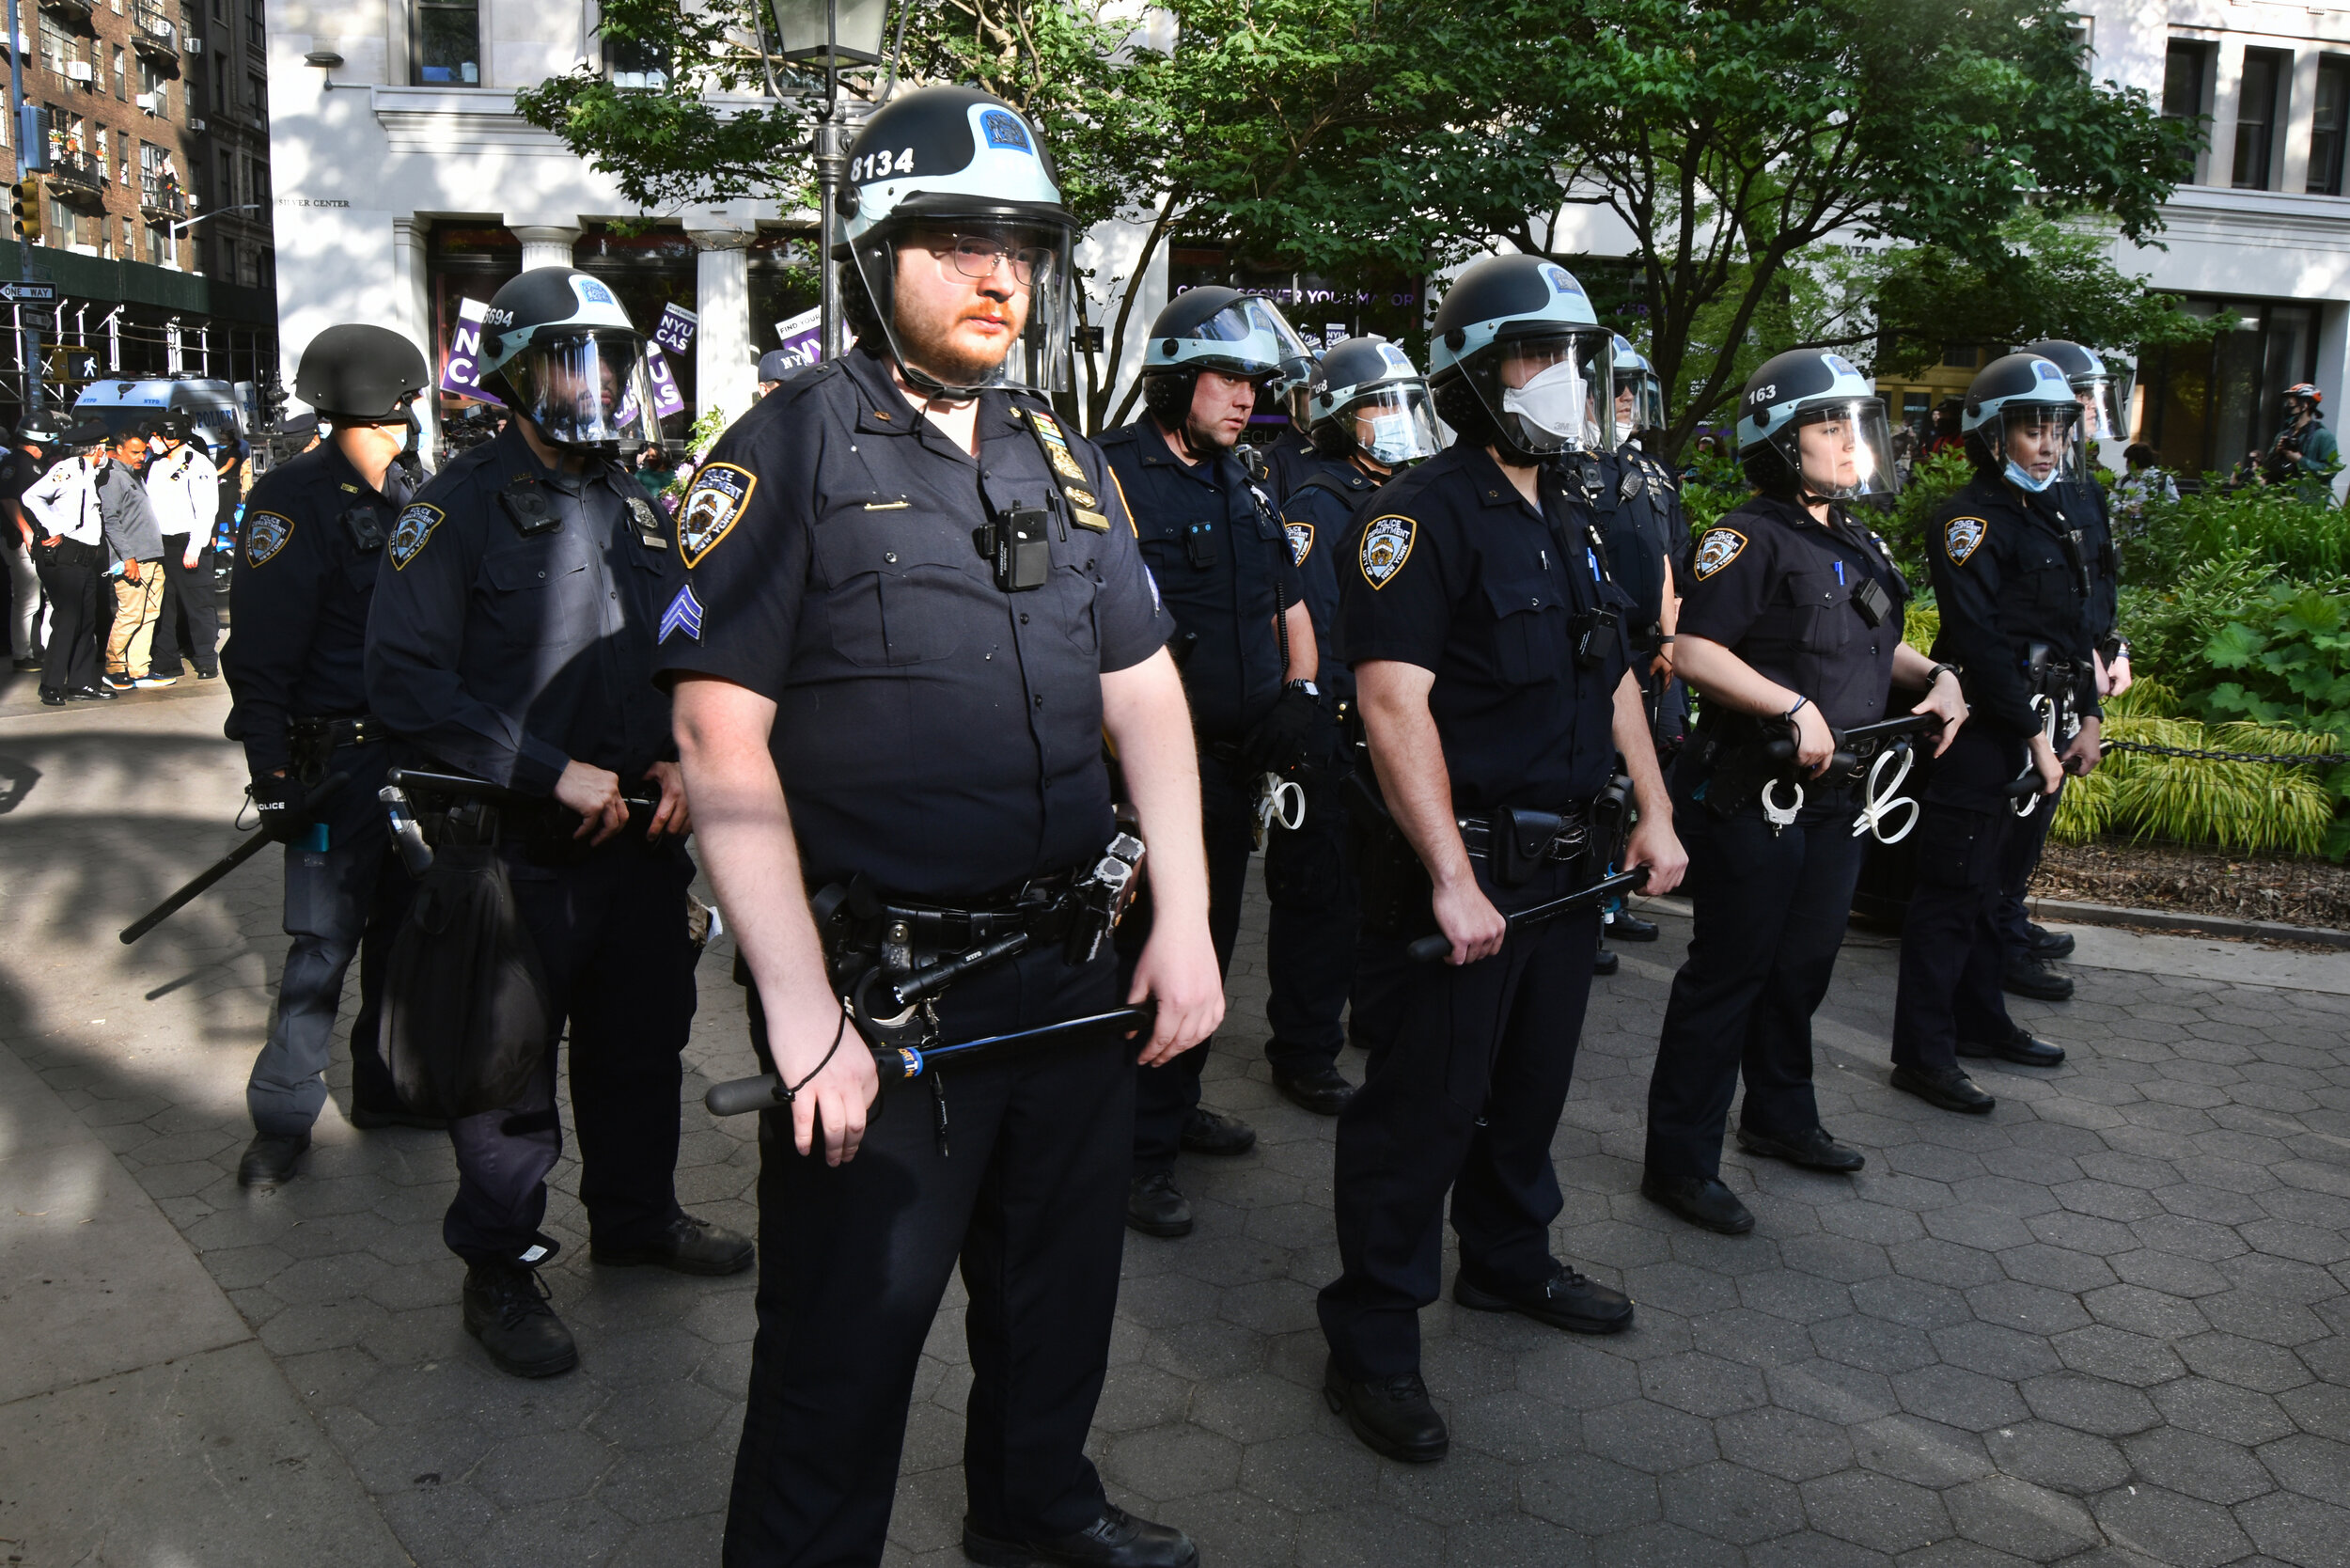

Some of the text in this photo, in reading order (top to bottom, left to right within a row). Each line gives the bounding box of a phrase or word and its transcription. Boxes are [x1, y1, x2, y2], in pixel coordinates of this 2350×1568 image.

[850, 147, 915, 182] 8134
[312, 199, 351, 208] CENTER
[5, 288, 49, 297] ONE WAY
[660, 315, 695, 337] NYU
[779, 322, 798, 335] FIND
[656, 329, 689, 352] CAS
[1748, 384, 1777, 405] 163
[196, 409, 232, 429] POLICE
[410, 506, 432, 516] POLICE
[694, 507, 738, 555] NEW YORK
[1375, 519, 1402, 528] POLICE
[415, 528, 430, 548] YORK
[1366, 525, 1411, 541] DEPARTMENT
[271, 538, 285, 553] YORK
[1380, 542, 1408, 580] NEW YORK
[258, 801, 286, 811] OLICE
